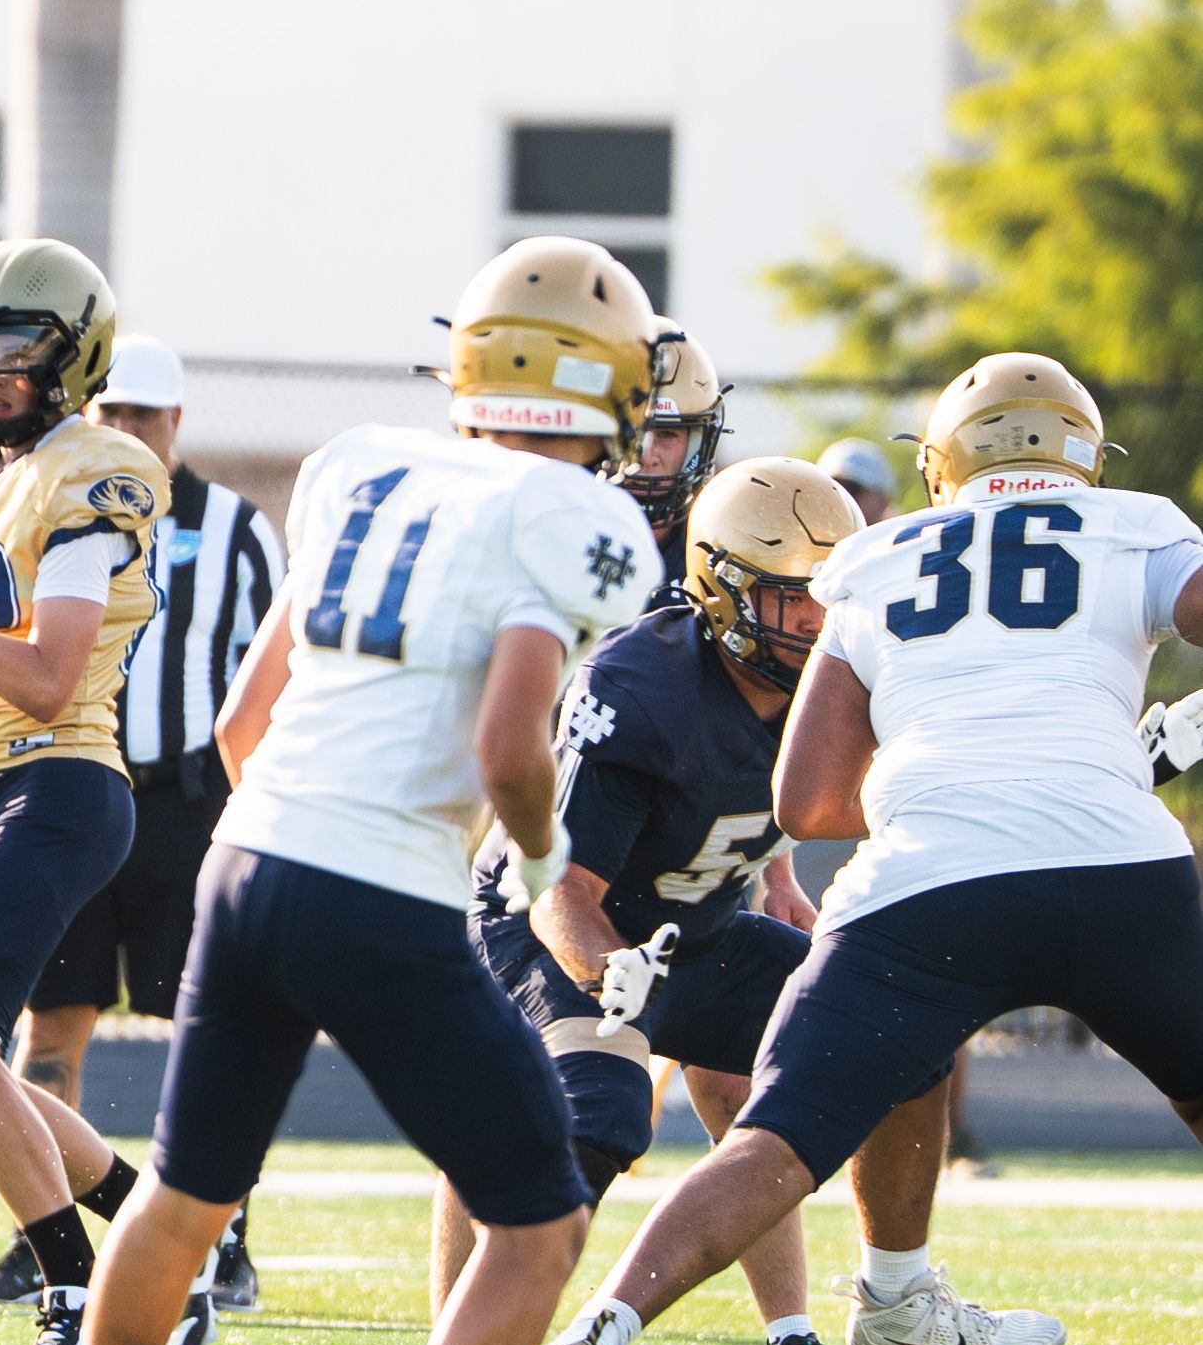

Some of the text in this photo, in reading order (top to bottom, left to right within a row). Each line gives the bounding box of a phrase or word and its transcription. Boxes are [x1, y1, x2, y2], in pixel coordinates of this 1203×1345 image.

[472, 404, 572, 427] Riddell
[304, 466, 441, 665] 11
[884, 503, 1084, 646] 36
